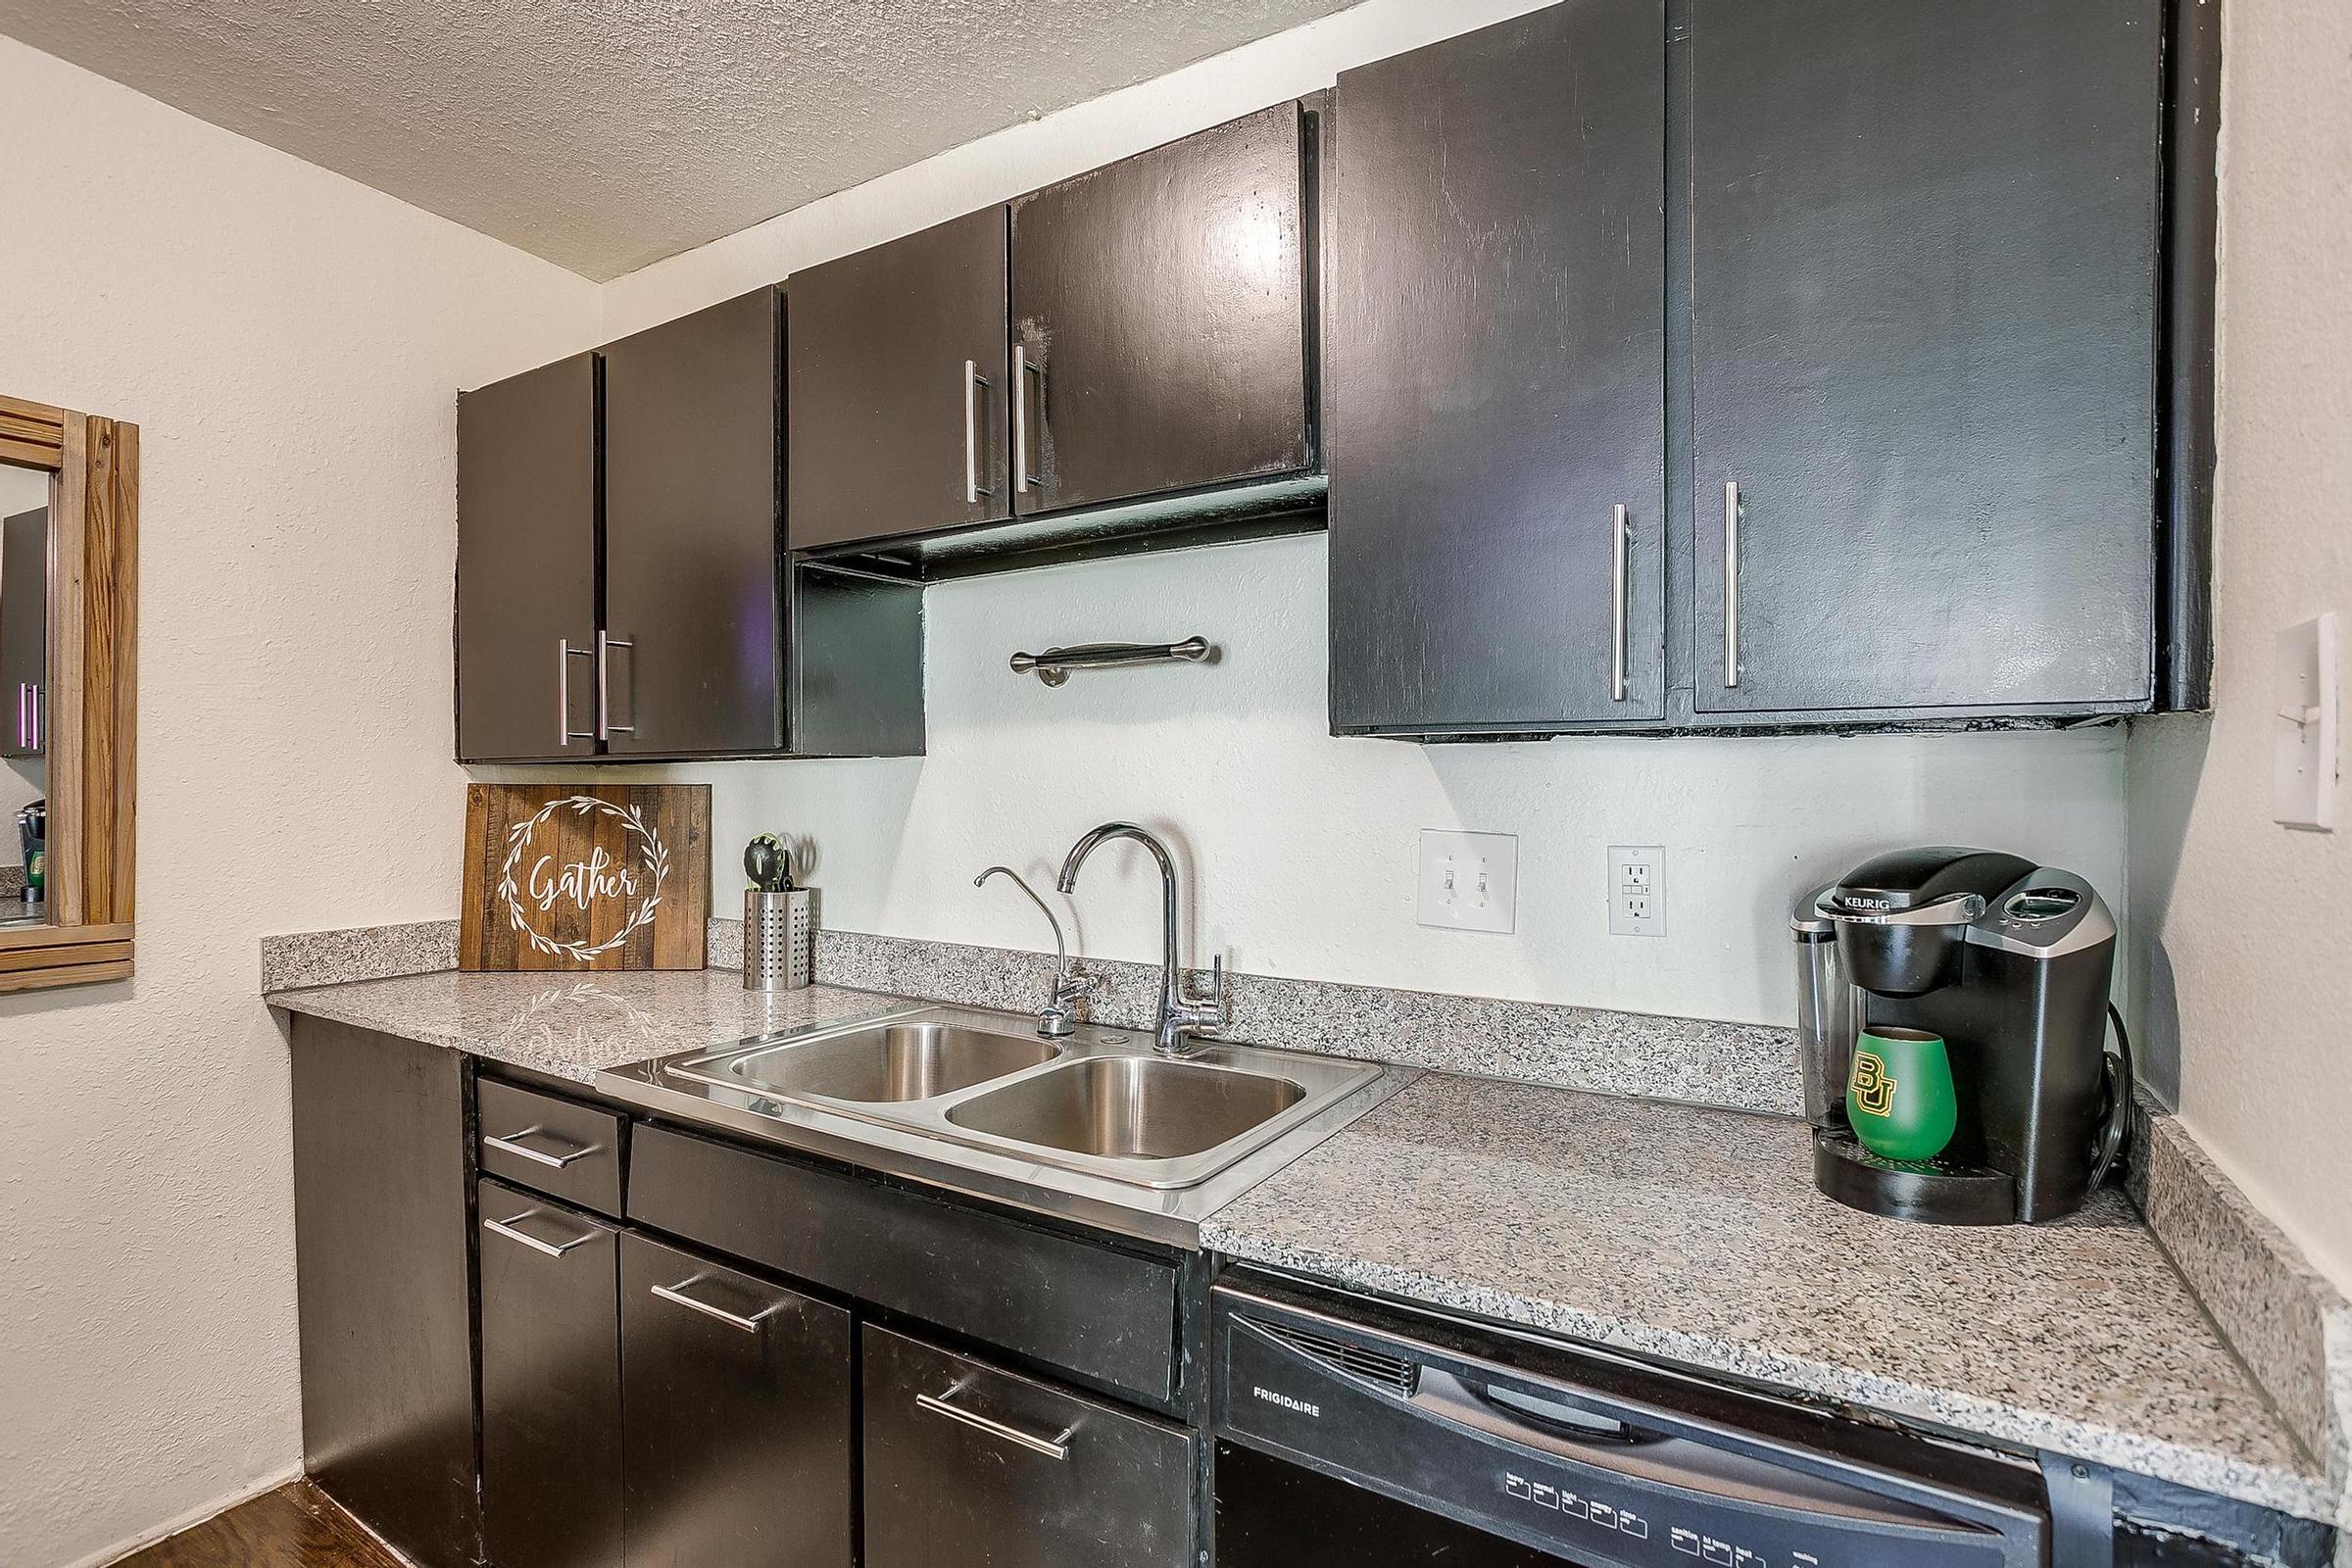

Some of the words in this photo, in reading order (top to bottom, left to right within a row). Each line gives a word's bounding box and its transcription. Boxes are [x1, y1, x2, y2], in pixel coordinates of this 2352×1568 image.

[530, 846, 637, 910] Gather
[1844, 896, 1890, 909] KEURIG
[1850, 1051, 1897, 1116] BU
[1253, 1386, 1320, 1417] FRIGIDAIRE
[1533, 1482, 1554, 1494] normal
